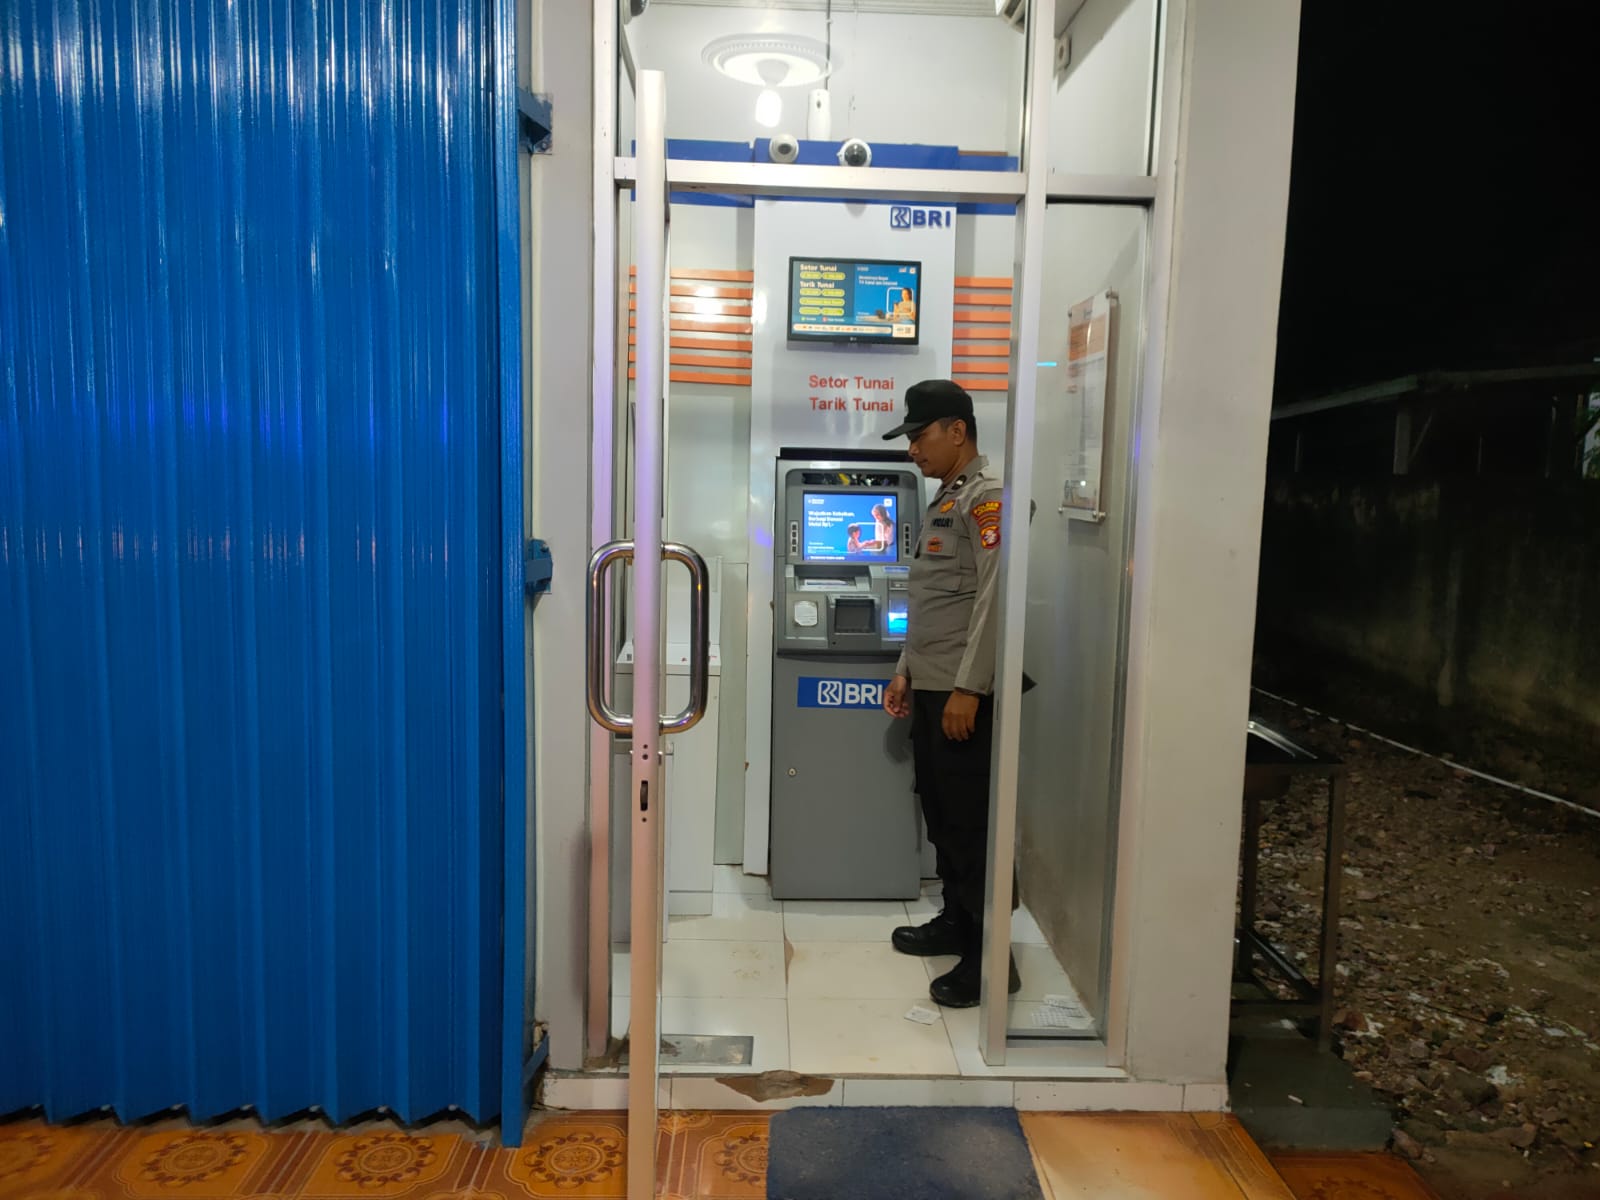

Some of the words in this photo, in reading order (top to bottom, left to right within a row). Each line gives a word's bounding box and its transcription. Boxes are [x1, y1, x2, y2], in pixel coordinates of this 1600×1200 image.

[912, 209, 951, 228] BRI
[809, 374, 848, 389] Setor
[854, 375, 894, 390] Tunai
[809, 396, 847, 411] Tarik
[853, 397, 894, 412] Tunai
[844, 683, 883, 705] BRI
